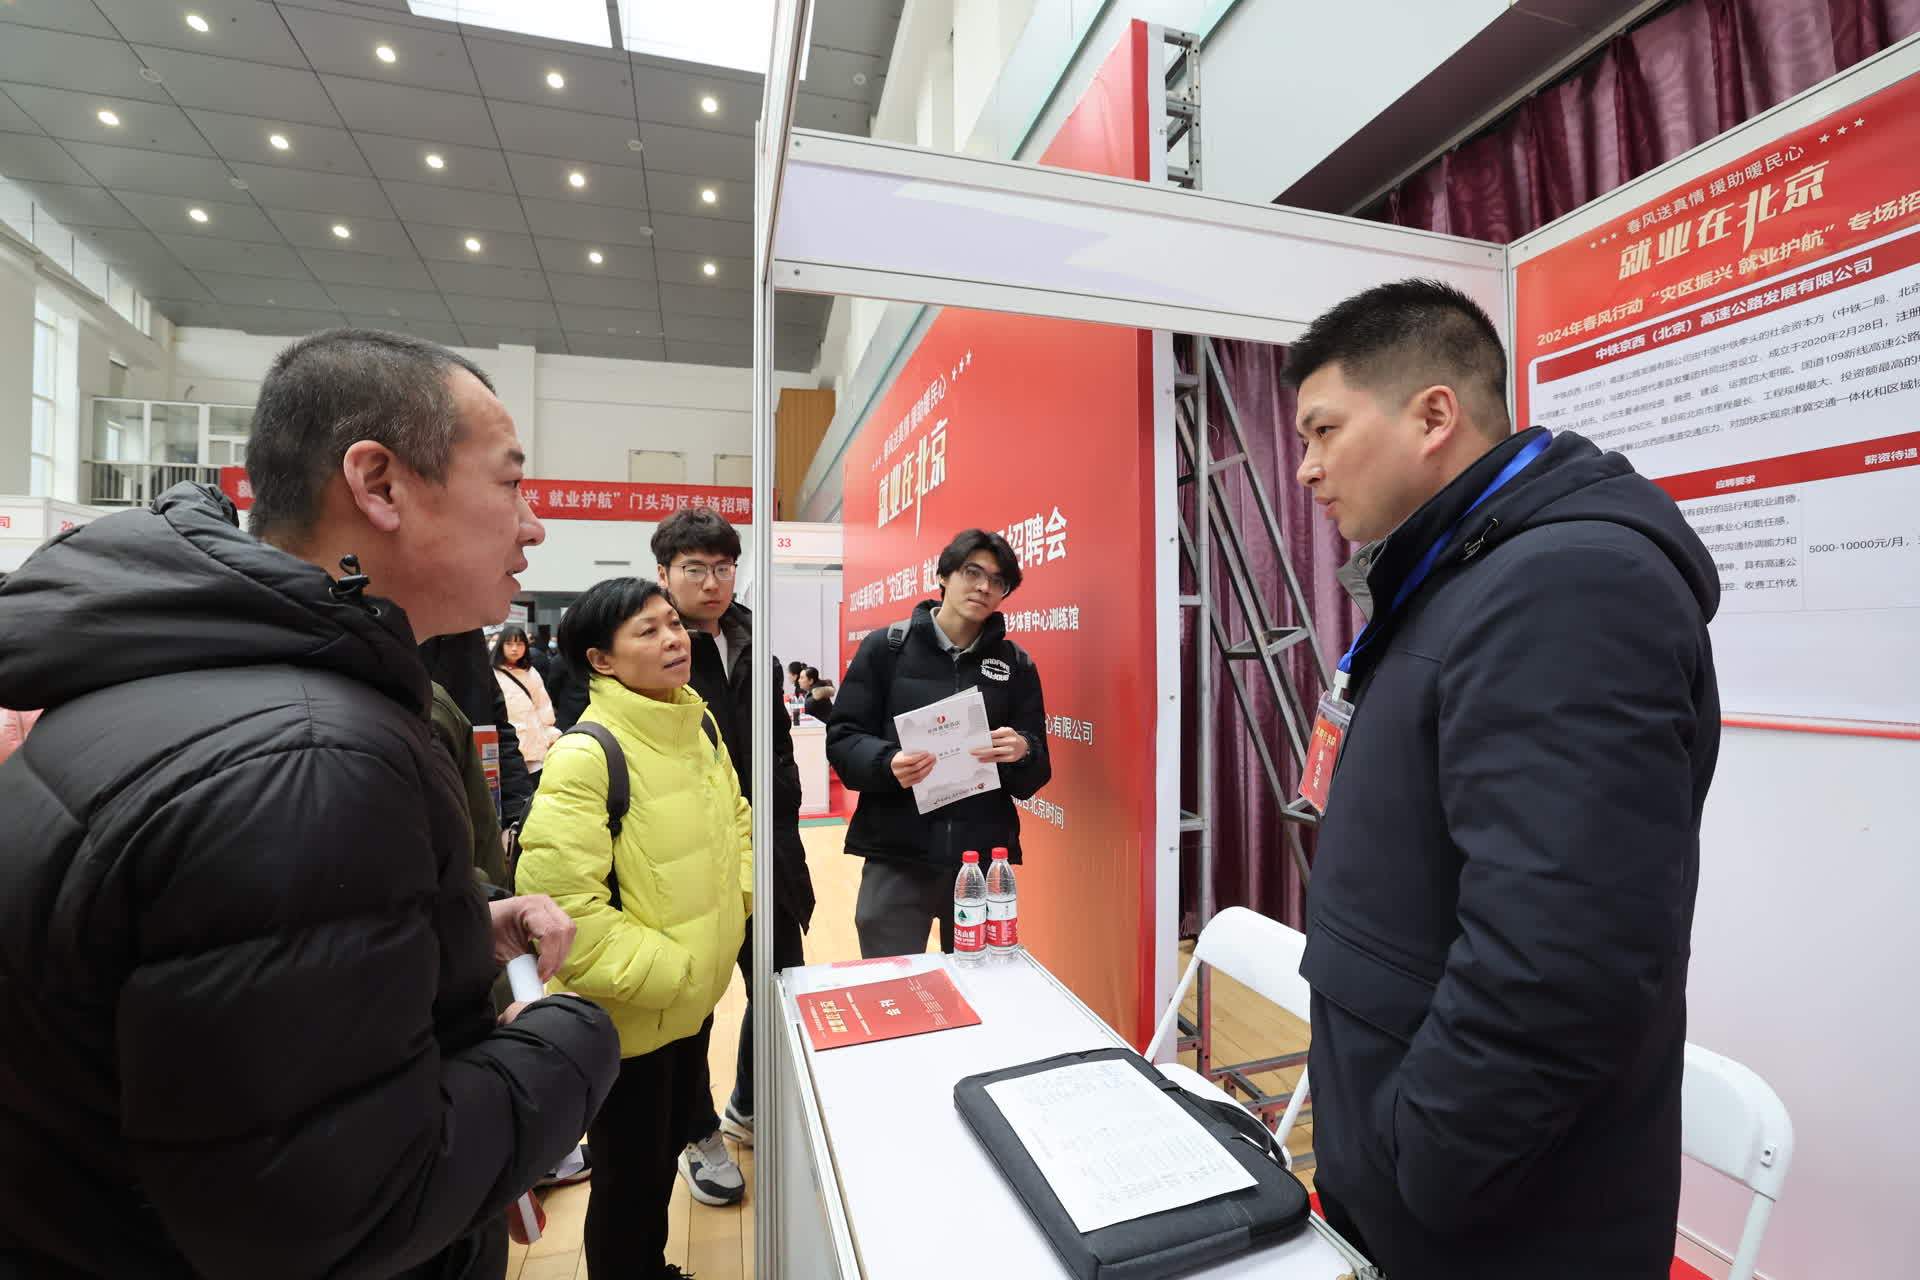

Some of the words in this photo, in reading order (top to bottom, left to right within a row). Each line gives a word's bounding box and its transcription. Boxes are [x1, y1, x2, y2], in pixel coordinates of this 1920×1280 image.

[1619, 160, 1829, 280] 就业在北京
[1627, 188, 1704, 234] 春风送真情
[1709, 146, 1804, 197] 援助暖民心
[1536, 297, 1643, 346] 2024年春风行动
[1738, 224, 1835, 275] 就业护航”
[878, 417, 948, 540] 就业在北京
[1864, 447, 1918, 466] 薪资待遇
[548, 489, 621, 509] 就业护航”
[629, 493, 752, 515] 门头沟区专场招聘
[777, 538, 792, 548] 33
[995, 505, 1068, 571] 招聘会
[1809, 536, 1920, 553] 5000-10000元/月，
